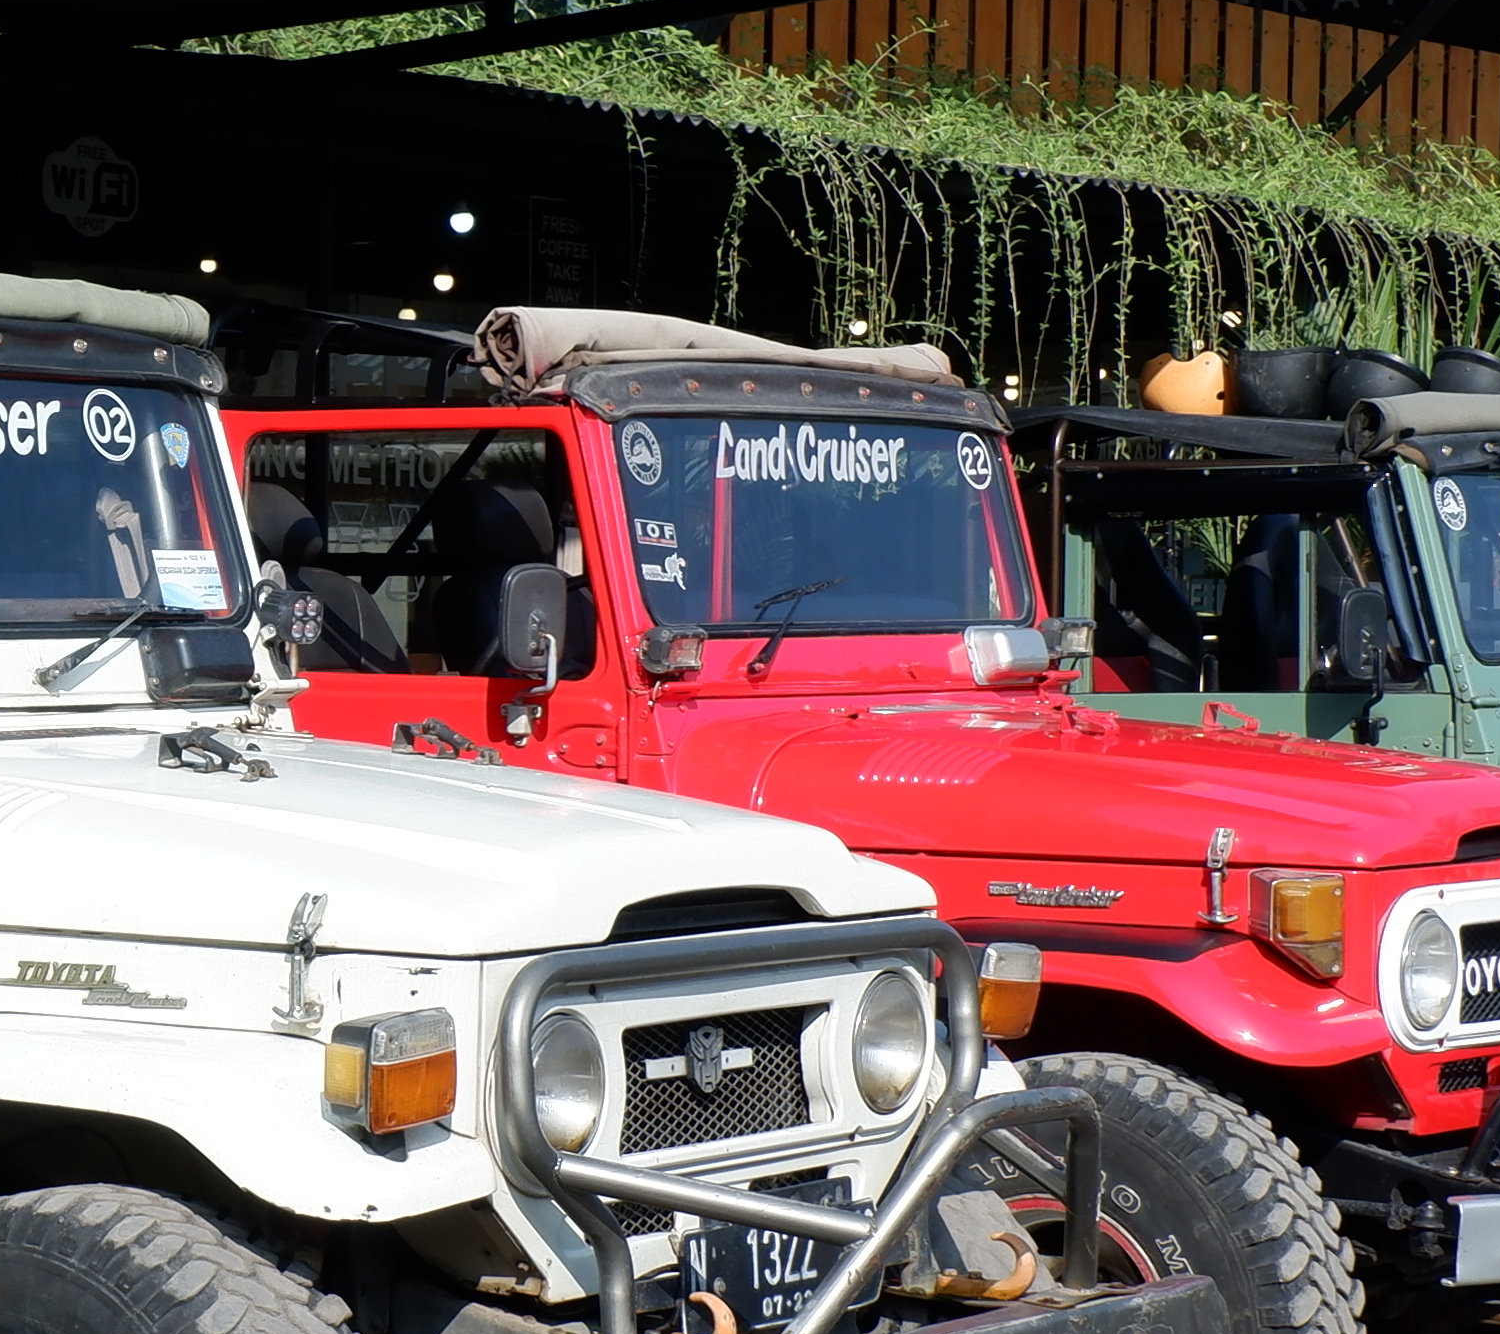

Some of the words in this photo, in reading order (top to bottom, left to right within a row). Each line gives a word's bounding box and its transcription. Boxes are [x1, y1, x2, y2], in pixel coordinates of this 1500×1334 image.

[77, 145, 107, 160] FREE
[76, 216, 106, 231] SPOT
[538, 238, 589, 259] COFFEE
[546, 262, 580, 281] TAKE
[545, 286, 581, 304] AWAY
[91, 404, 132, 445] 02
[715, 420, 787, 481] Land
[797, 422, 905, 484] Cruiser
[961, 445, 990, 477] 22
[16, 961, 117, 986] TOYOTA
